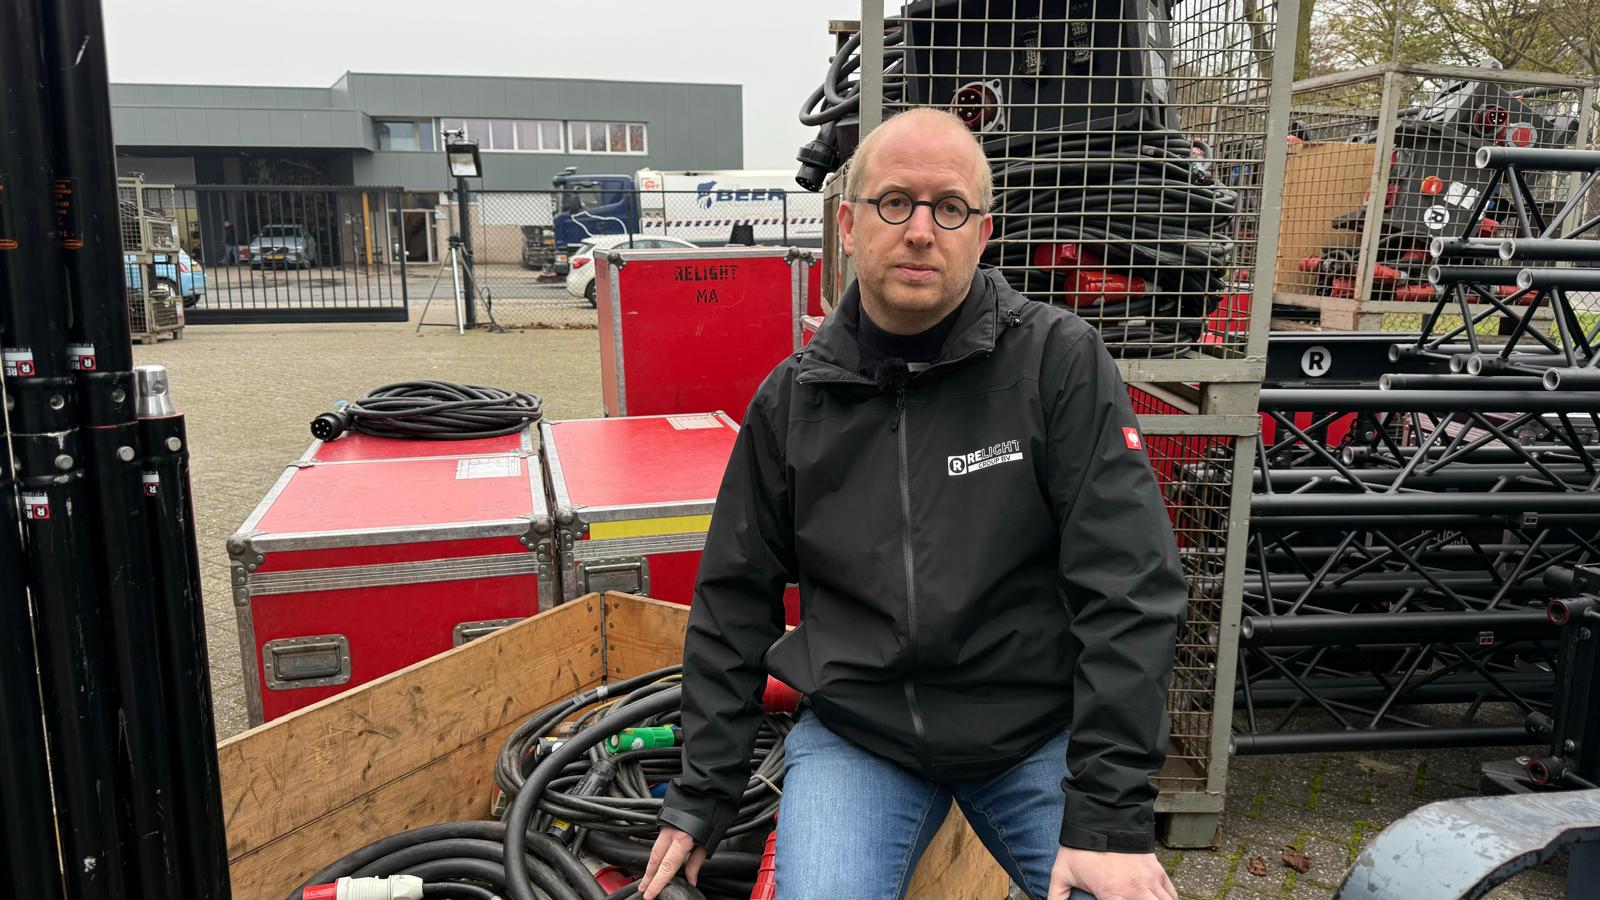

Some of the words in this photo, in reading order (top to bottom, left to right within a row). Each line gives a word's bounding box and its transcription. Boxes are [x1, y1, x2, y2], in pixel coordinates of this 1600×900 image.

[674, 264, 738, 281] RELIGHT
[696, 288, 719, 304] MA
[967, 439, 1020, 465] RELIGHT
[978, 456, 1000, 469] GROUP
[1000, 454, 1011, 463] BV
